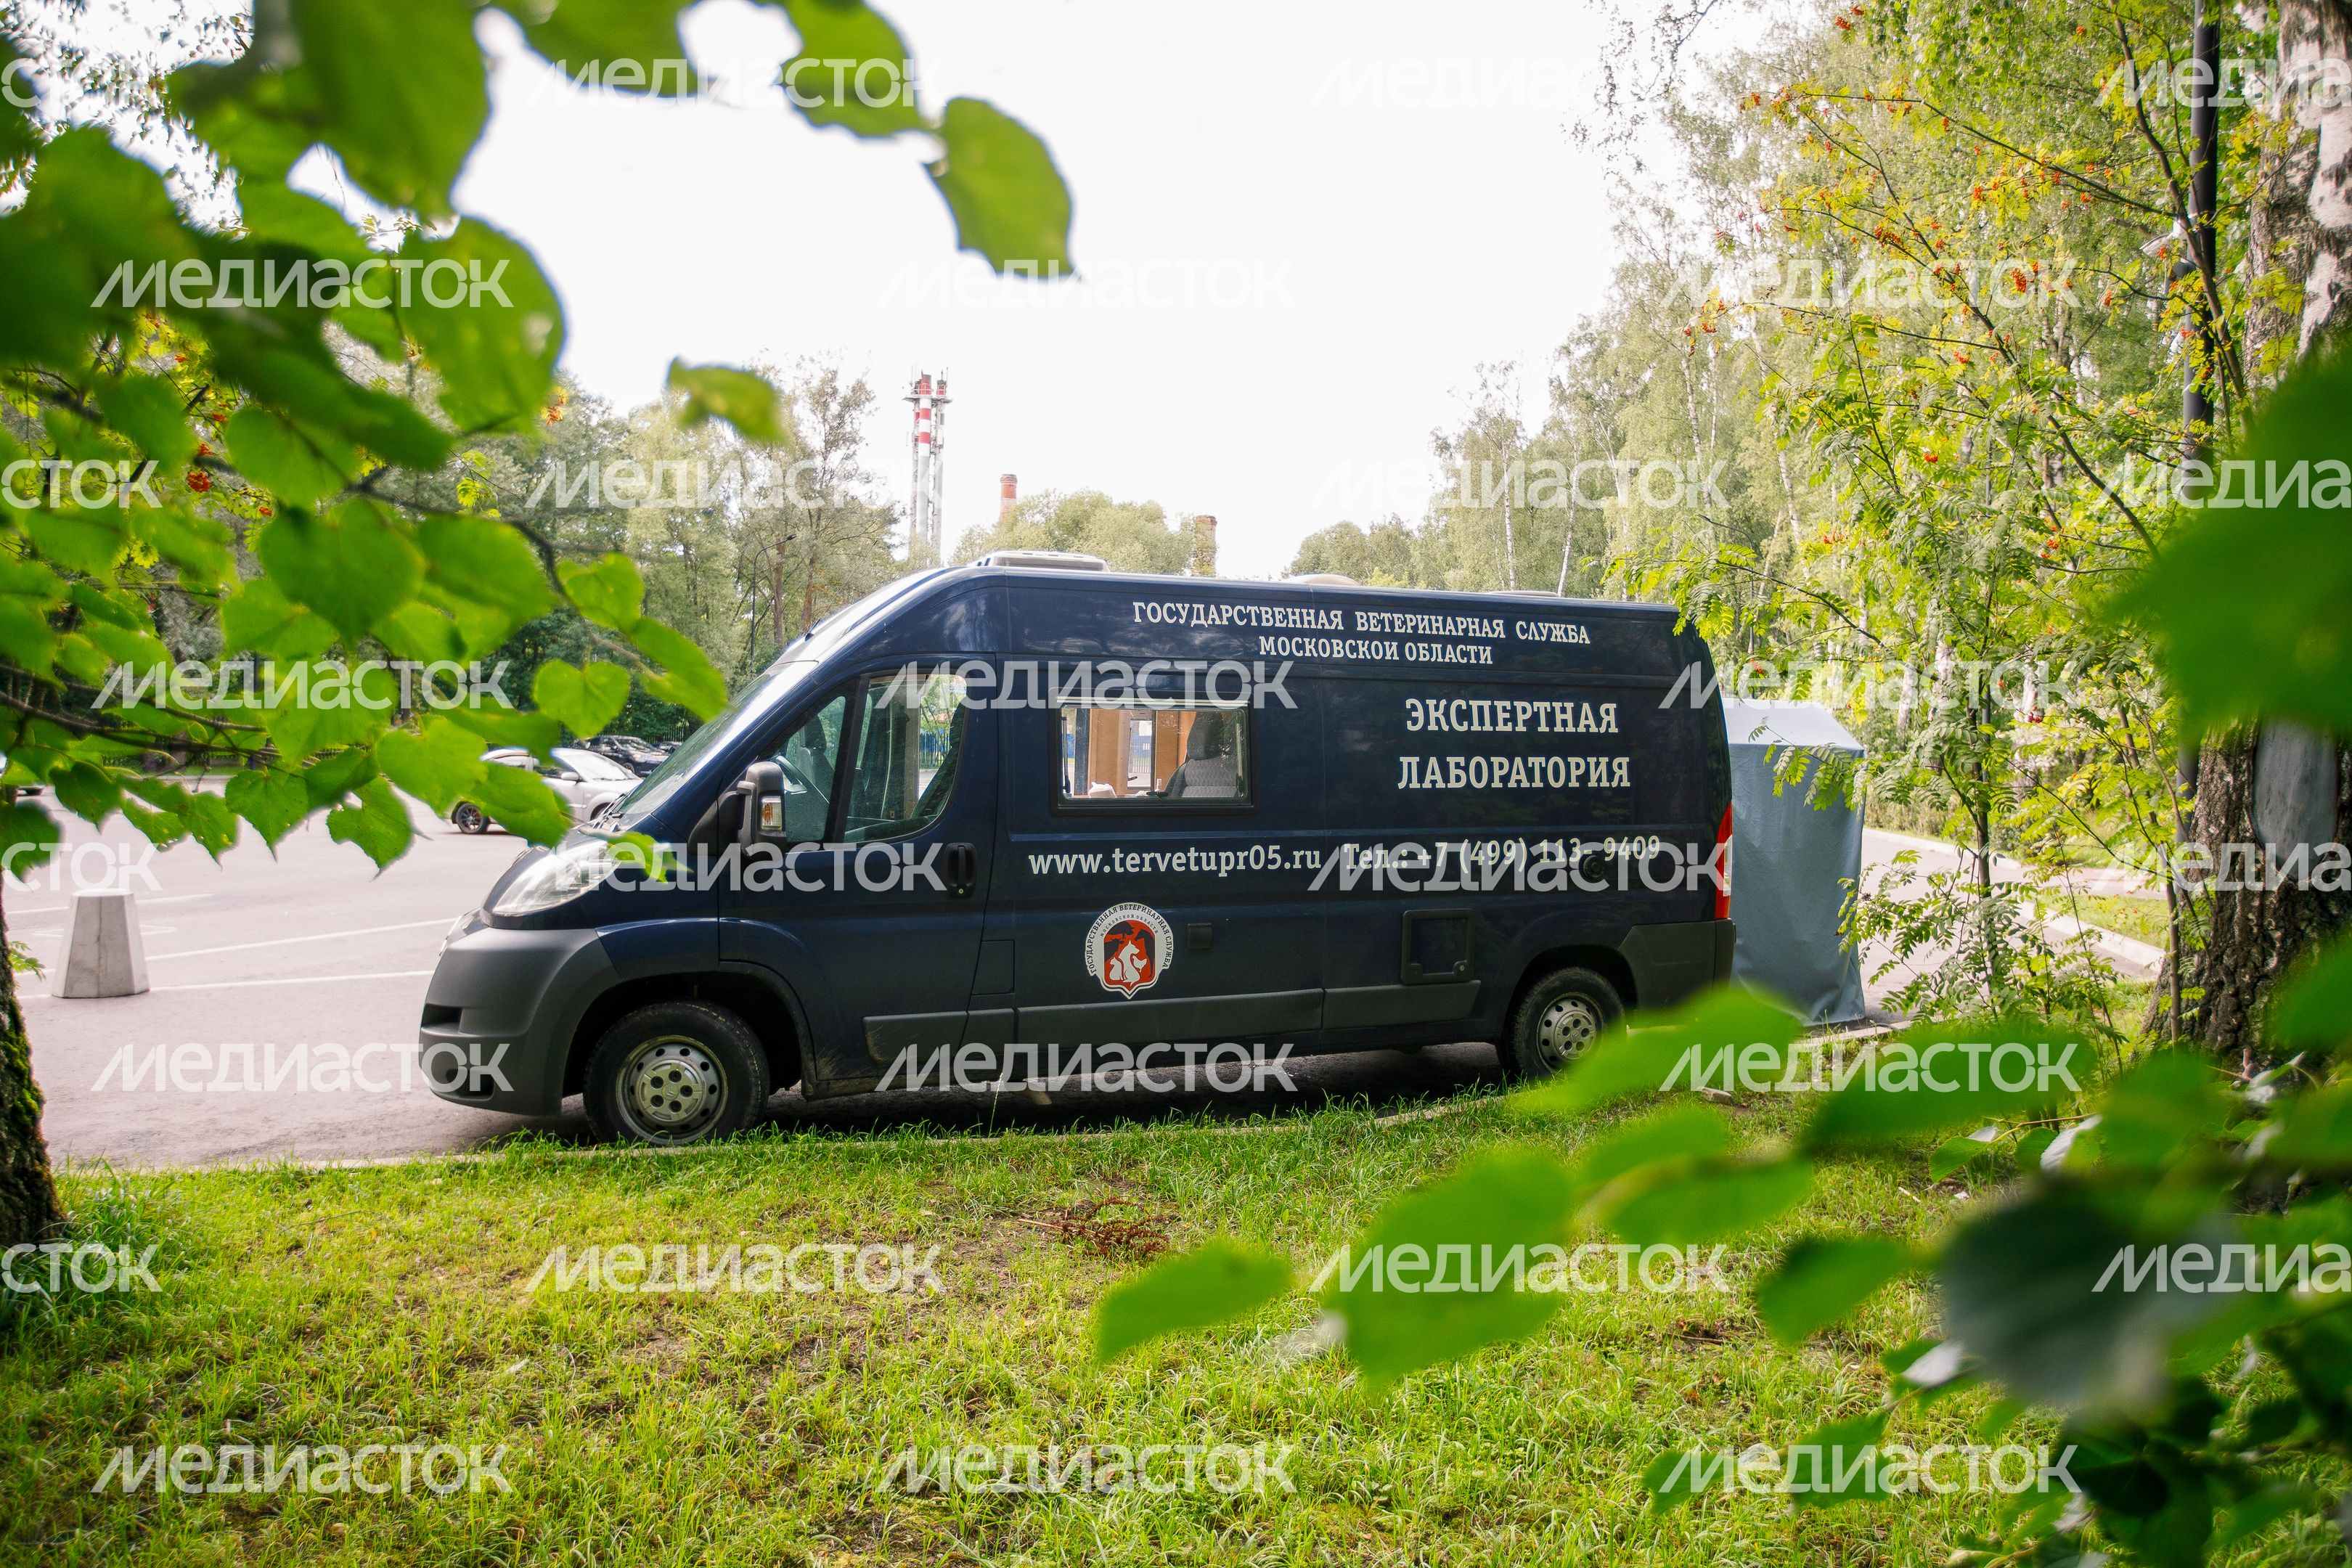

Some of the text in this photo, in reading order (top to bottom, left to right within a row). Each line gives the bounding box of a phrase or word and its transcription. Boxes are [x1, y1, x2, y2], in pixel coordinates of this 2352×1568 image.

[1133, 601, 1591, 645] ГОСУДАРСТВЕННАЯ ВЕТЕРИНАРНАЯ СЛУЖБА
[1405, 642, 1493, 664] ОБЛАСТИ
[1405, 698, 1619, 733] ЭКСПЕРТНАЯ
[1397, 756, 1630, 789] ЛАБОРАТОРИЯ
[1028, 844, 1322, 878] www.tervetupr05.ru
[1460, 837, 1527, 874] (499)
[1086, 903, 1173, 974] ГОСУДАРСТВЕННАЯ ВЕТЕРИНАРНАЯ СЛУЖБА
